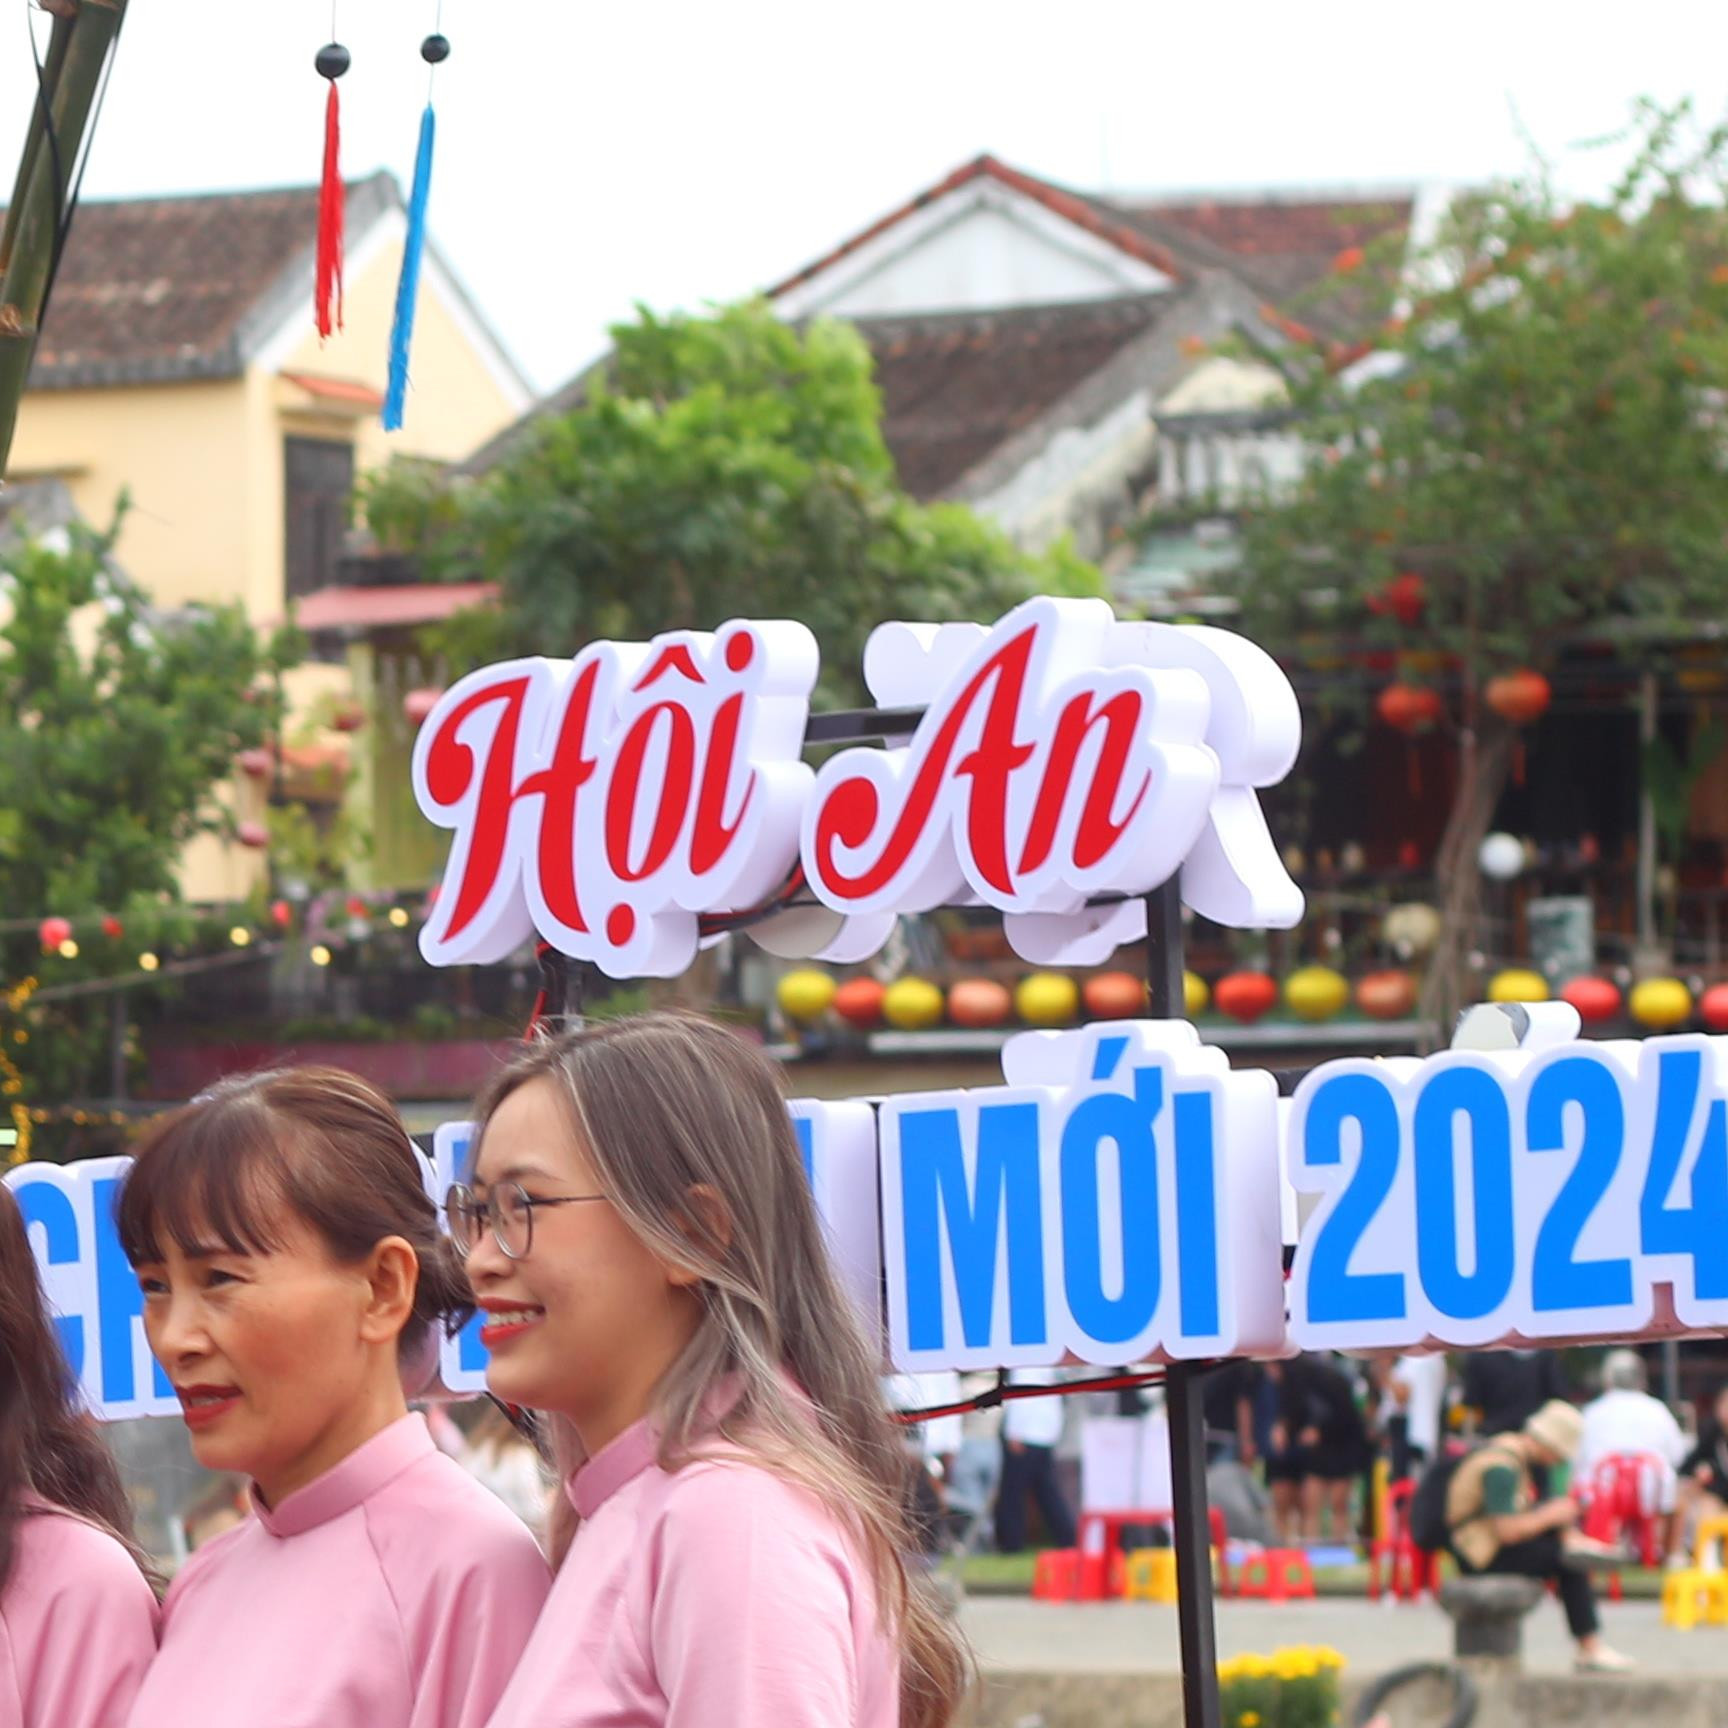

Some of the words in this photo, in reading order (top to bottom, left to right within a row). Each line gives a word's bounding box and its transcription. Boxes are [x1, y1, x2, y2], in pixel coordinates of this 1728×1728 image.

[426, 629, 756, 947] Hội
[815, 623, 1151, 899] An
[897, 1036, 1220, 1352] MỚI
[1304, 1050, 1728, 1324] 2024
